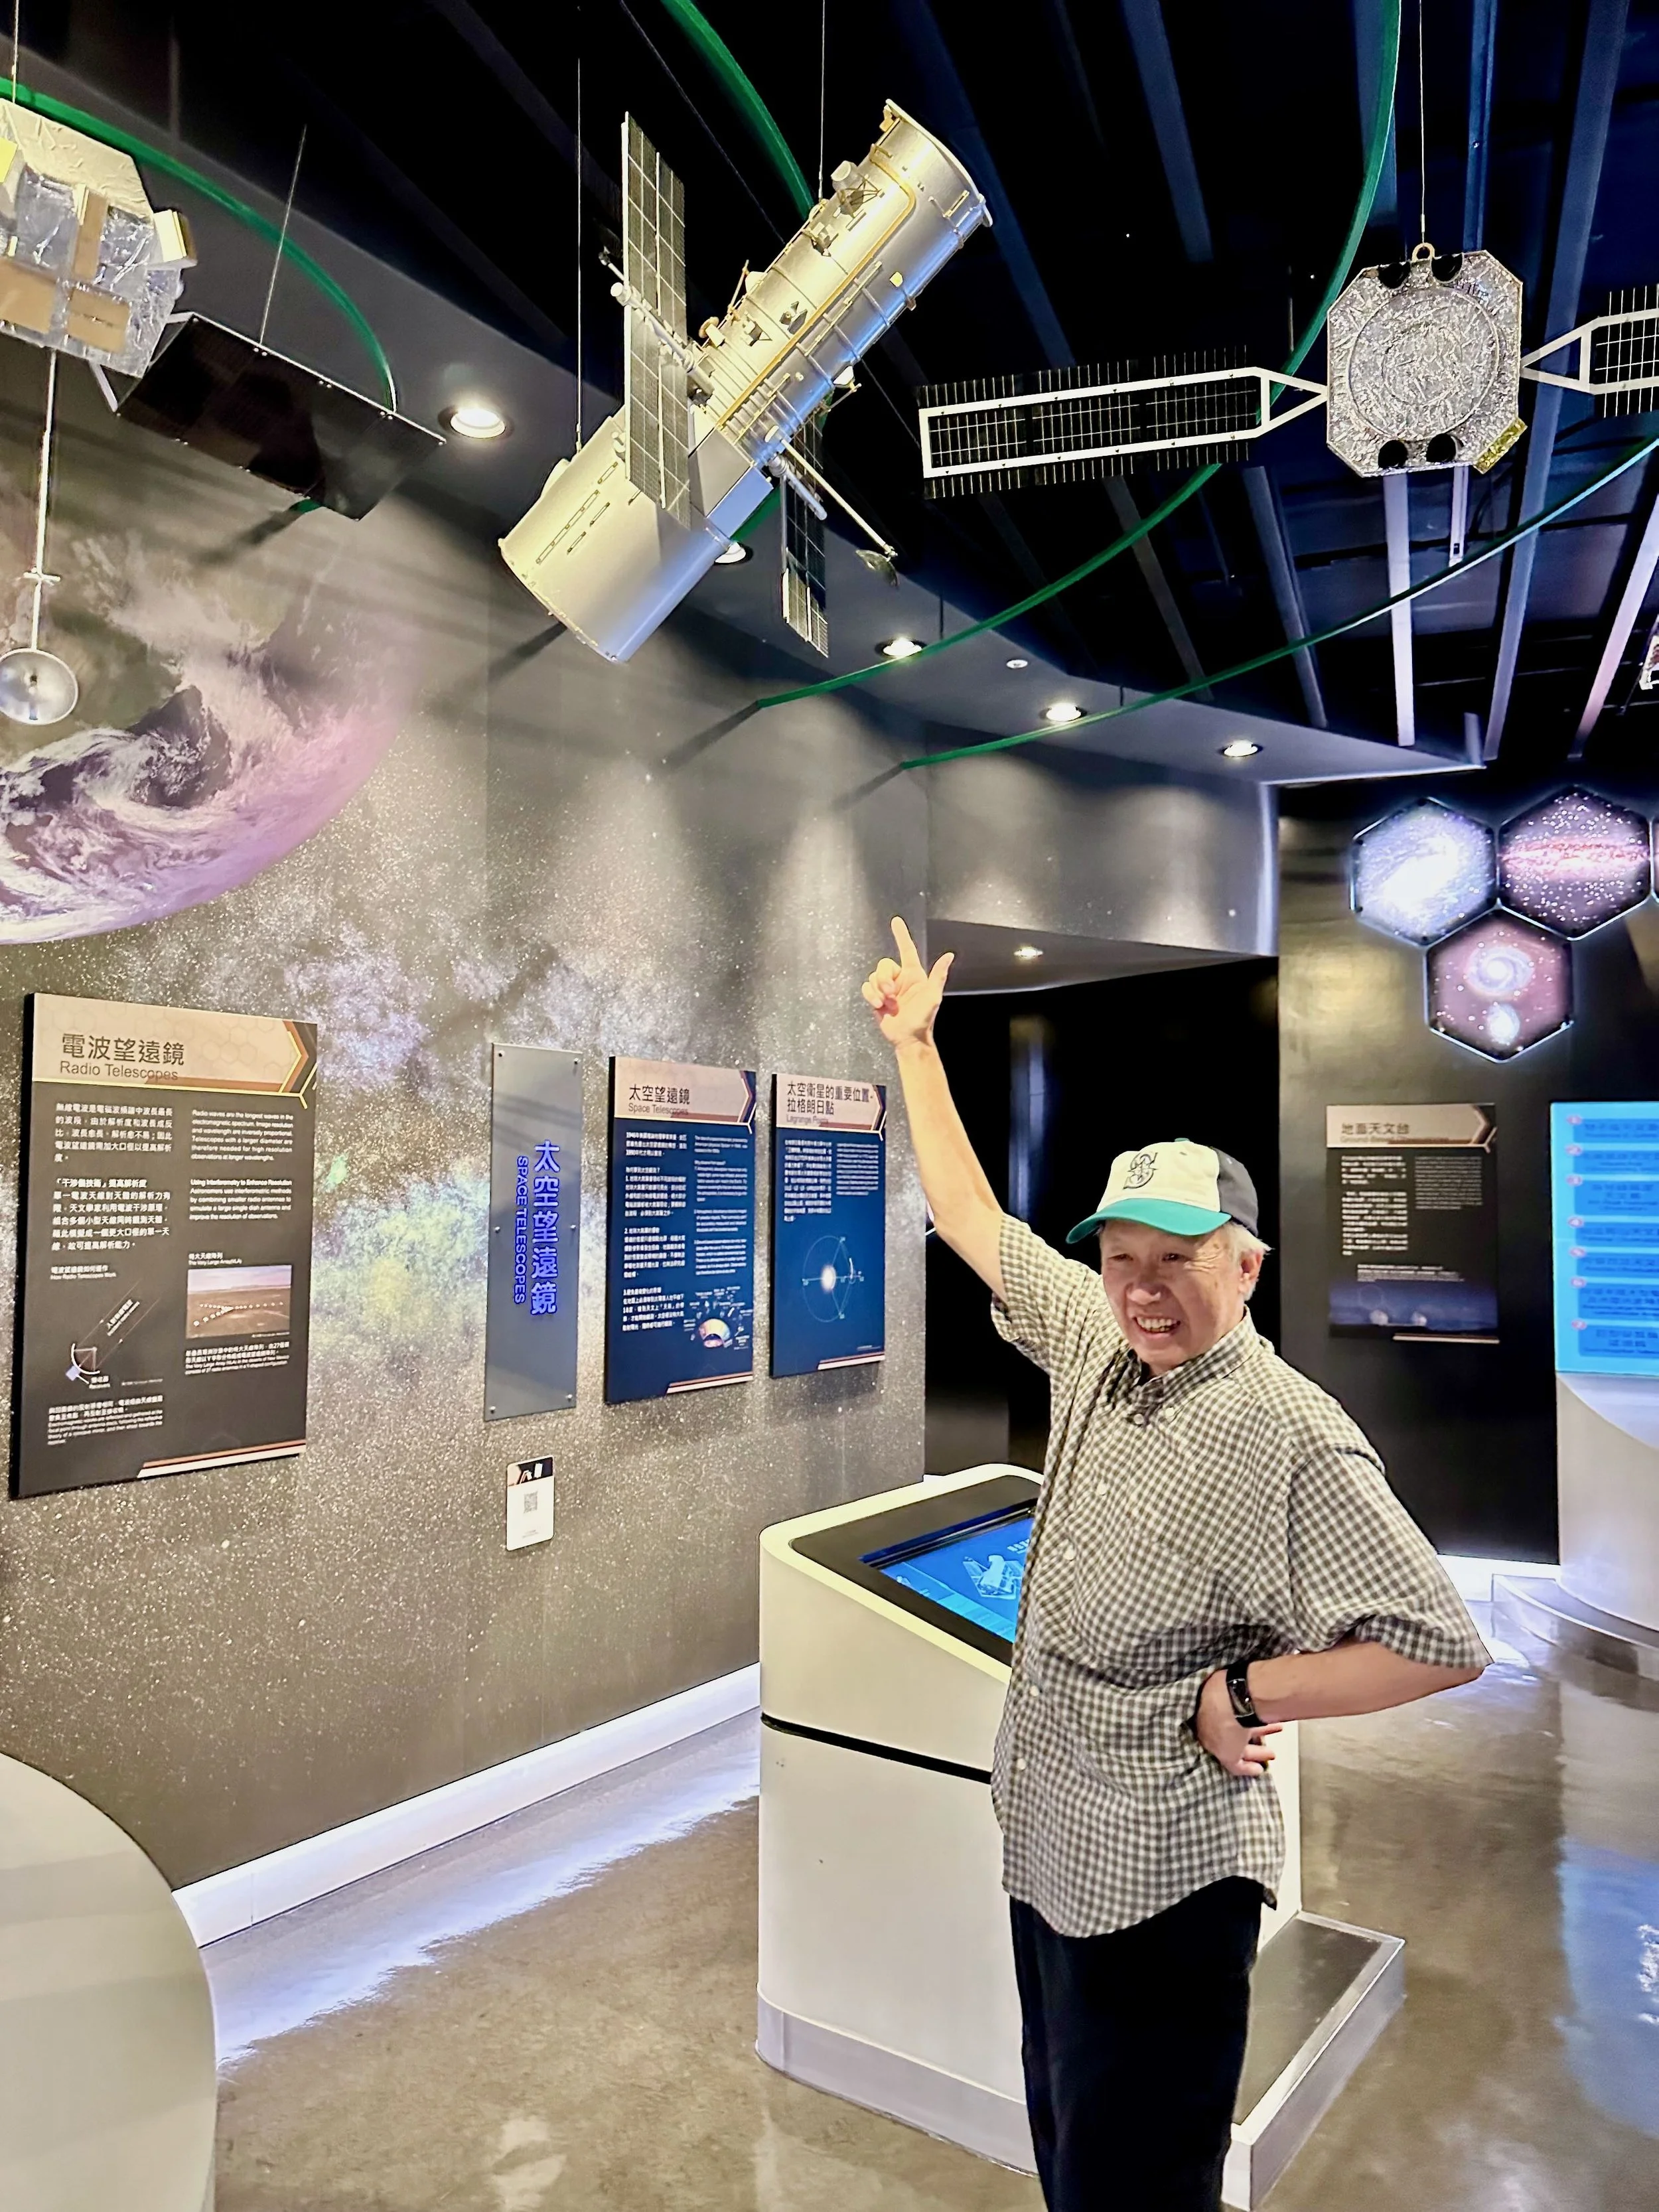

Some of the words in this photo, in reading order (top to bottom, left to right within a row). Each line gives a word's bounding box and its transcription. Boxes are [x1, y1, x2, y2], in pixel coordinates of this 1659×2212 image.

[62, 1033, 184, 1066] 電波望遠鏡
[60, 1061, 100, 1075] Radio
[105, 1064, 179, 1082] Telescopes
[629, 1084, 689, 1104] 太空望遠鏡
[788, 1098, 833, 1115] 拉格朗日點
[628, 1103, 650, 1114] Space
[652, 1104, 688, 1115] Telescopes
[516, 1155, 529, 1206] SPACE
[531, 1140, 560, 1315] 太空望遠鏡
[514, 1208, 528, 1304] TELESCOPES
